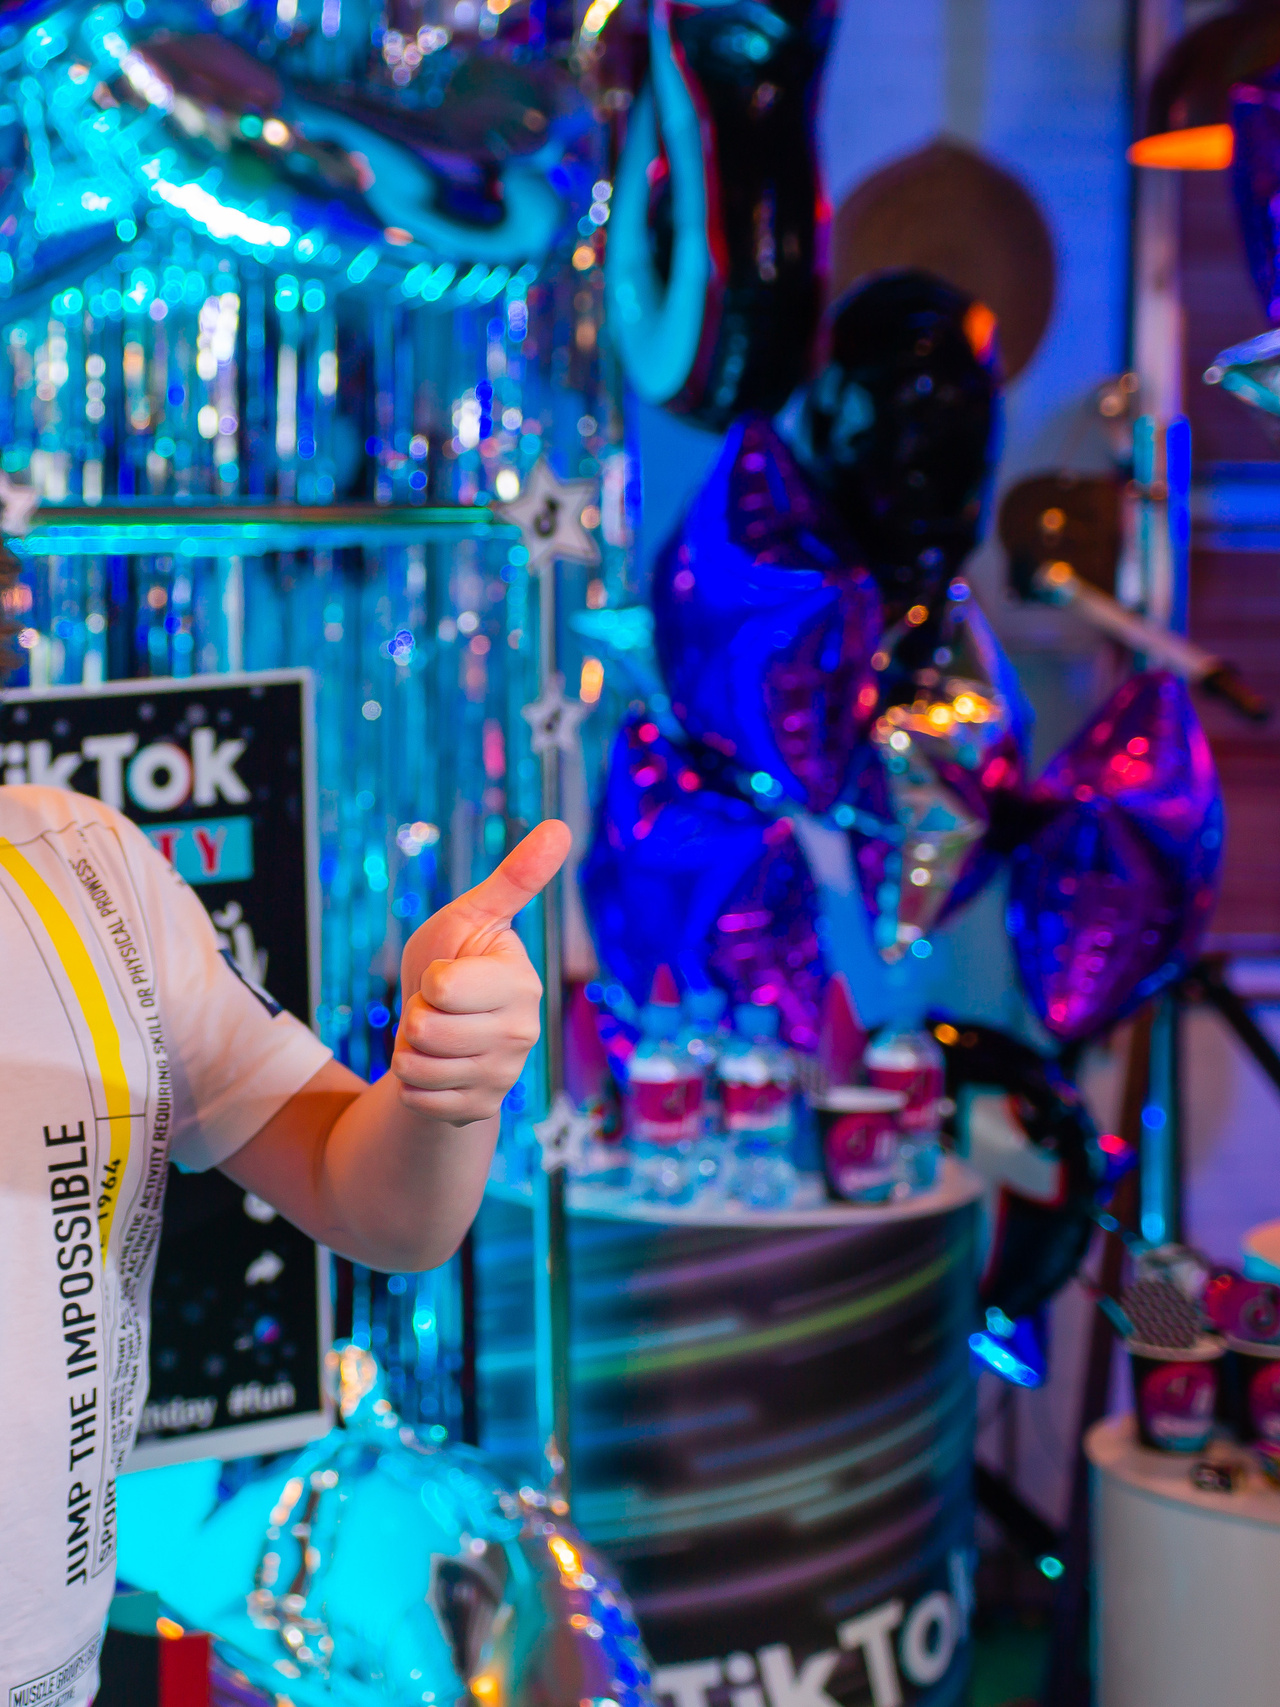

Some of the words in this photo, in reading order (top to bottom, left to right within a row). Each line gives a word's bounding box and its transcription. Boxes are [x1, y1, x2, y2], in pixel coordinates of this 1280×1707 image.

[107, 917, 148, 984] PHYSICAL
[137, 988, 156, 1008] OR
[146, 1016, 166, 1055] SKILL
[153, 1060, 172, 1142] REQUIRING
[97, 1159, 121, 1221] 1964
[139, 1146, 165, 1209] ACTIVITY
[42, 1120, 97, 1381] IMPOSSIBLE
[69, 1387, 98, 1473] THE
[66, 1481, 92, 1586] JUMP
